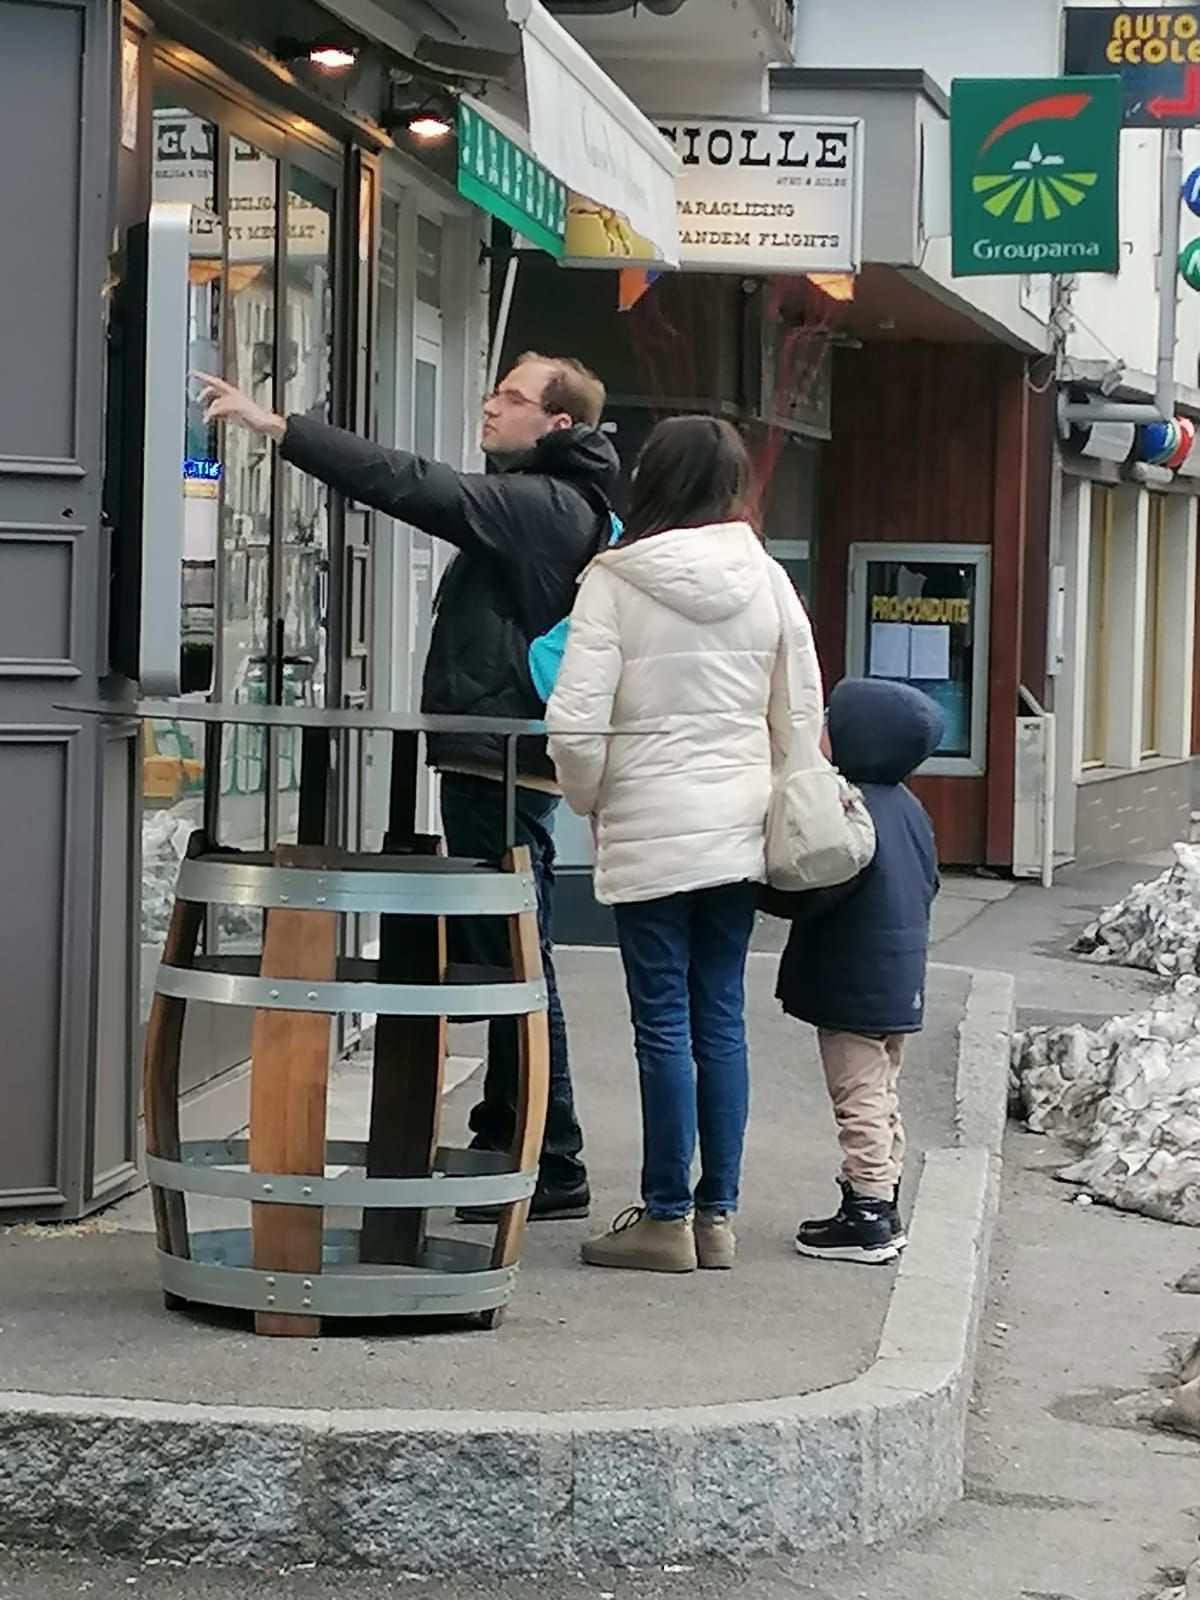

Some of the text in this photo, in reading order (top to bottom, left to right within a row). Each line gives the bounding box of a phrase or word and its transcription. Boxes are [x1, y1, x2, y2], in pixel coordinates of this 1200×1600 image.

[1112, 13, 1198, 39] AUTO
[679, 231, 840, 248] ANDEM FLIGHTS
[972, 239, 1100, 262] Groupama
